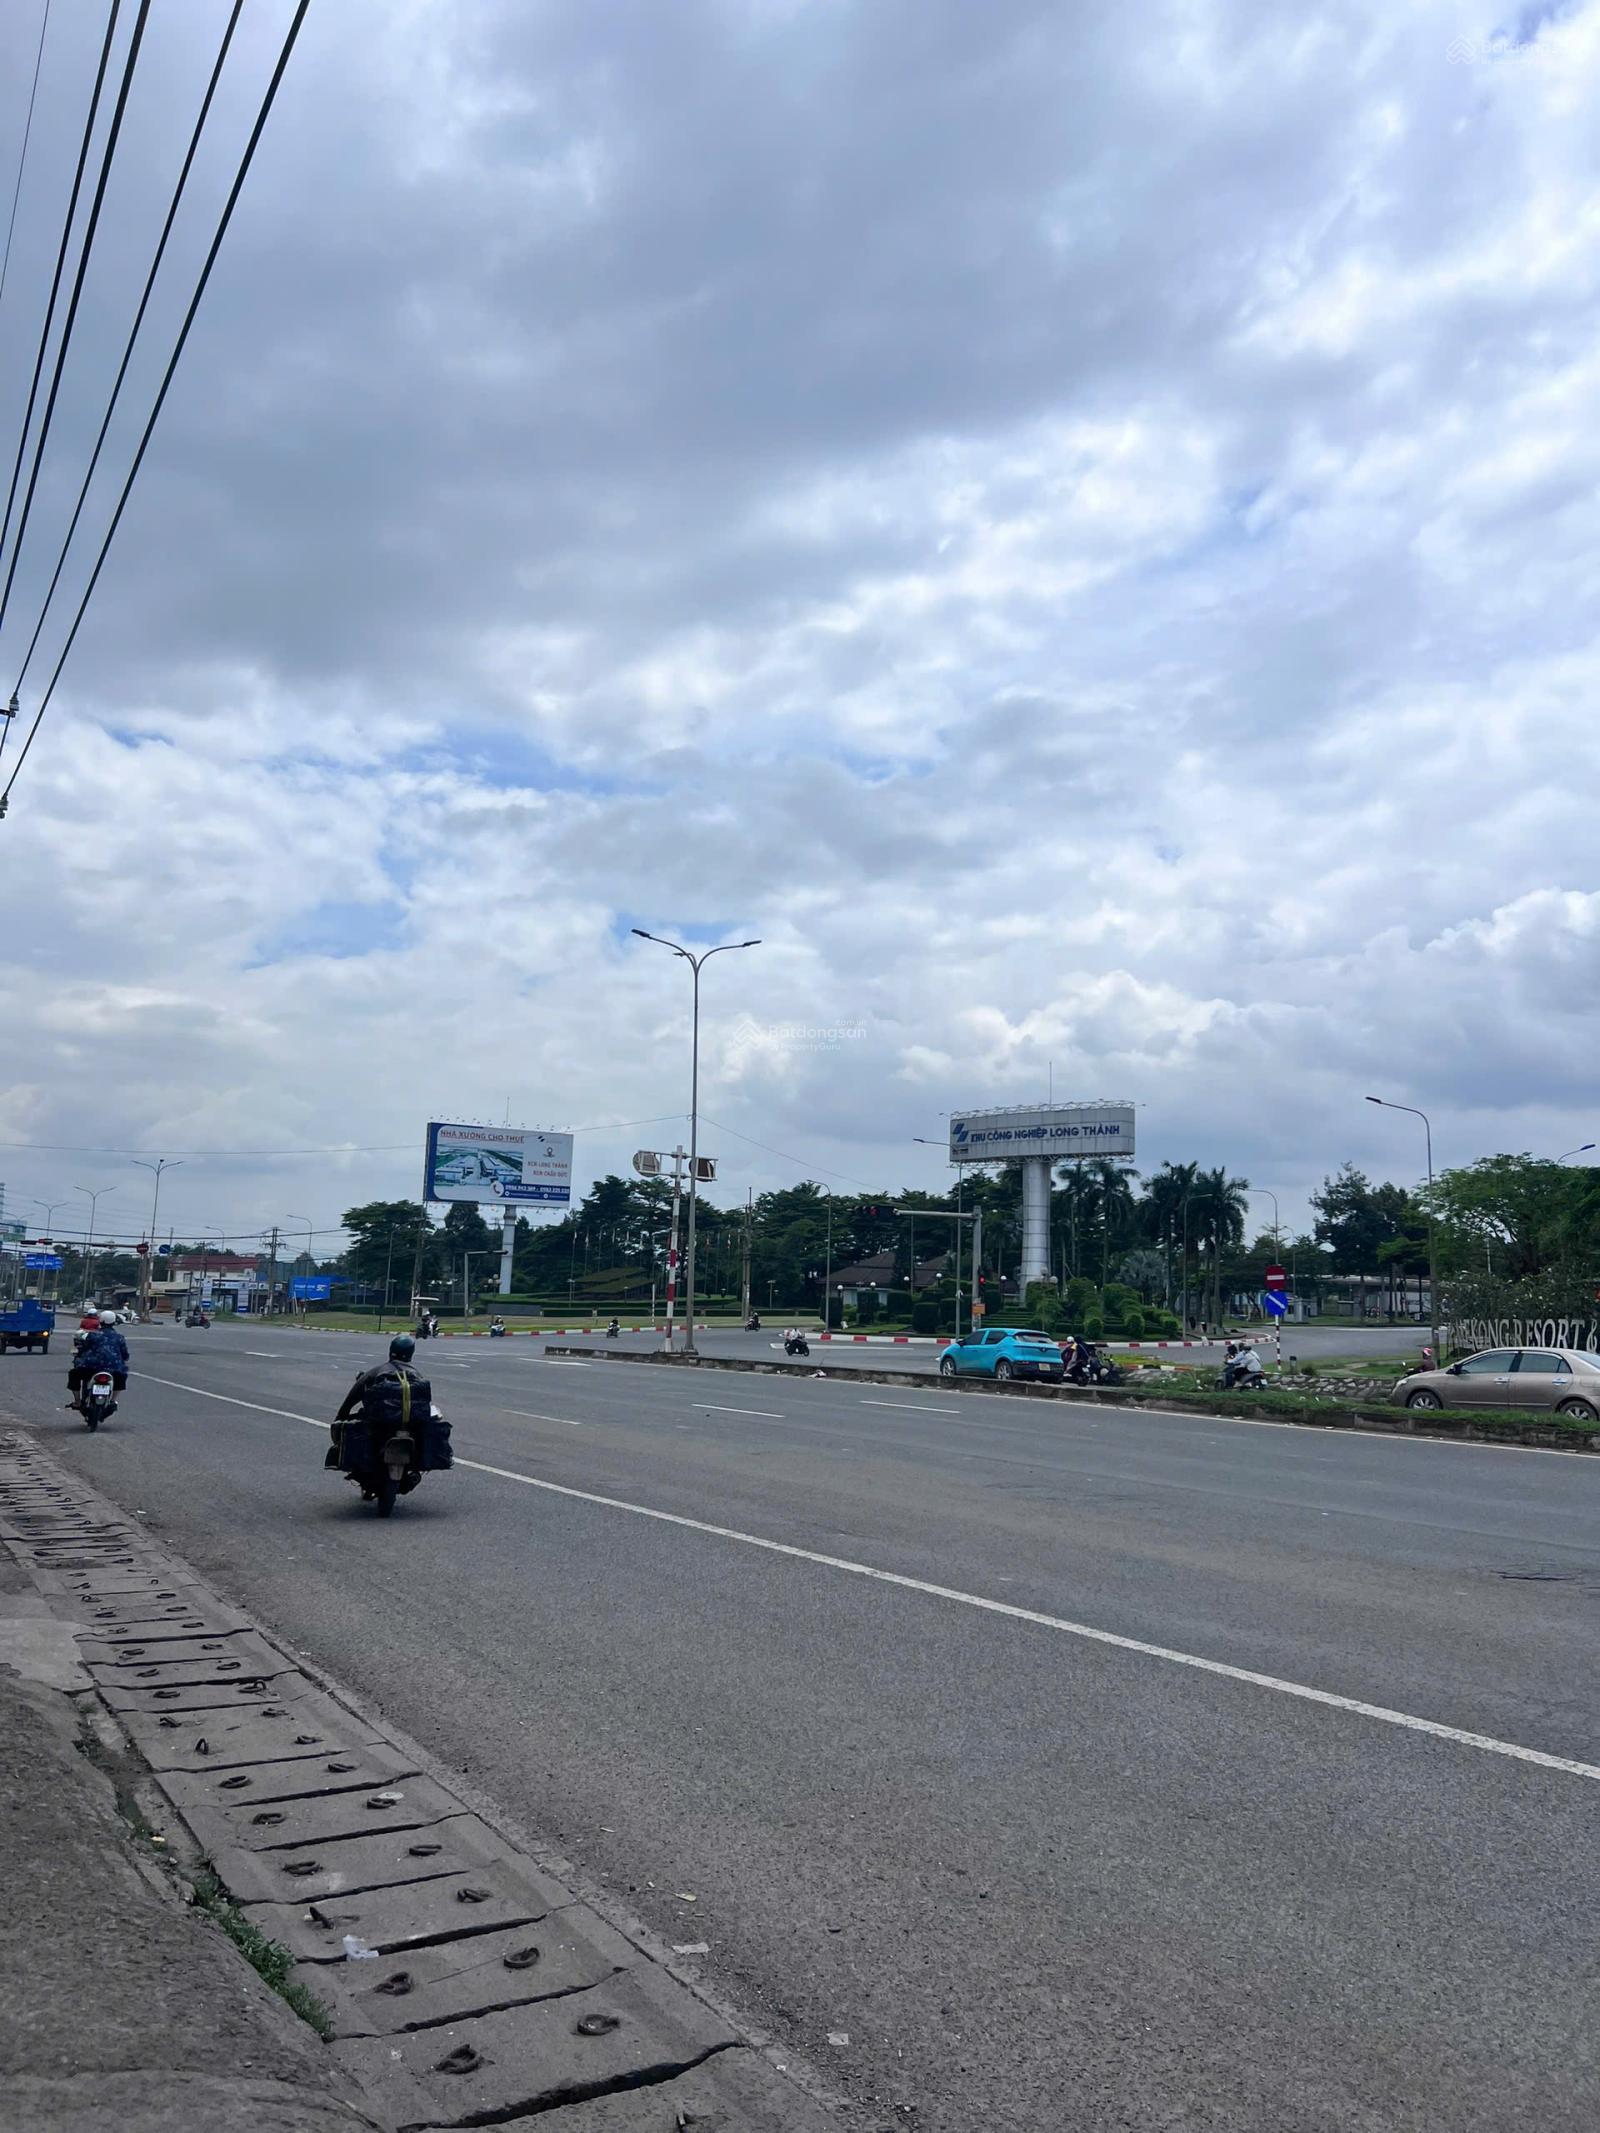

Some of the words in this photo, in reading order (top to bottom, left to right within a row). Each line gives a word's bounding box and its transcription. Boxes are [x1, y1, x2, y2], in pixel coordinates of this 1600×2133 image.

[487, 1133, 504, 1142] CHO
[971, 1132, 986, 1143] KHU
[986, 1129, 1013, 1142] CÔNG
[1014, 1126, 1049, 1140] NGHIỆP
[1049, 1126, 1080, 1138] LONG
[1082, 1122, 1120, 1136] THÀNH
[1512, 1317, 1586, 1350] RESORT
